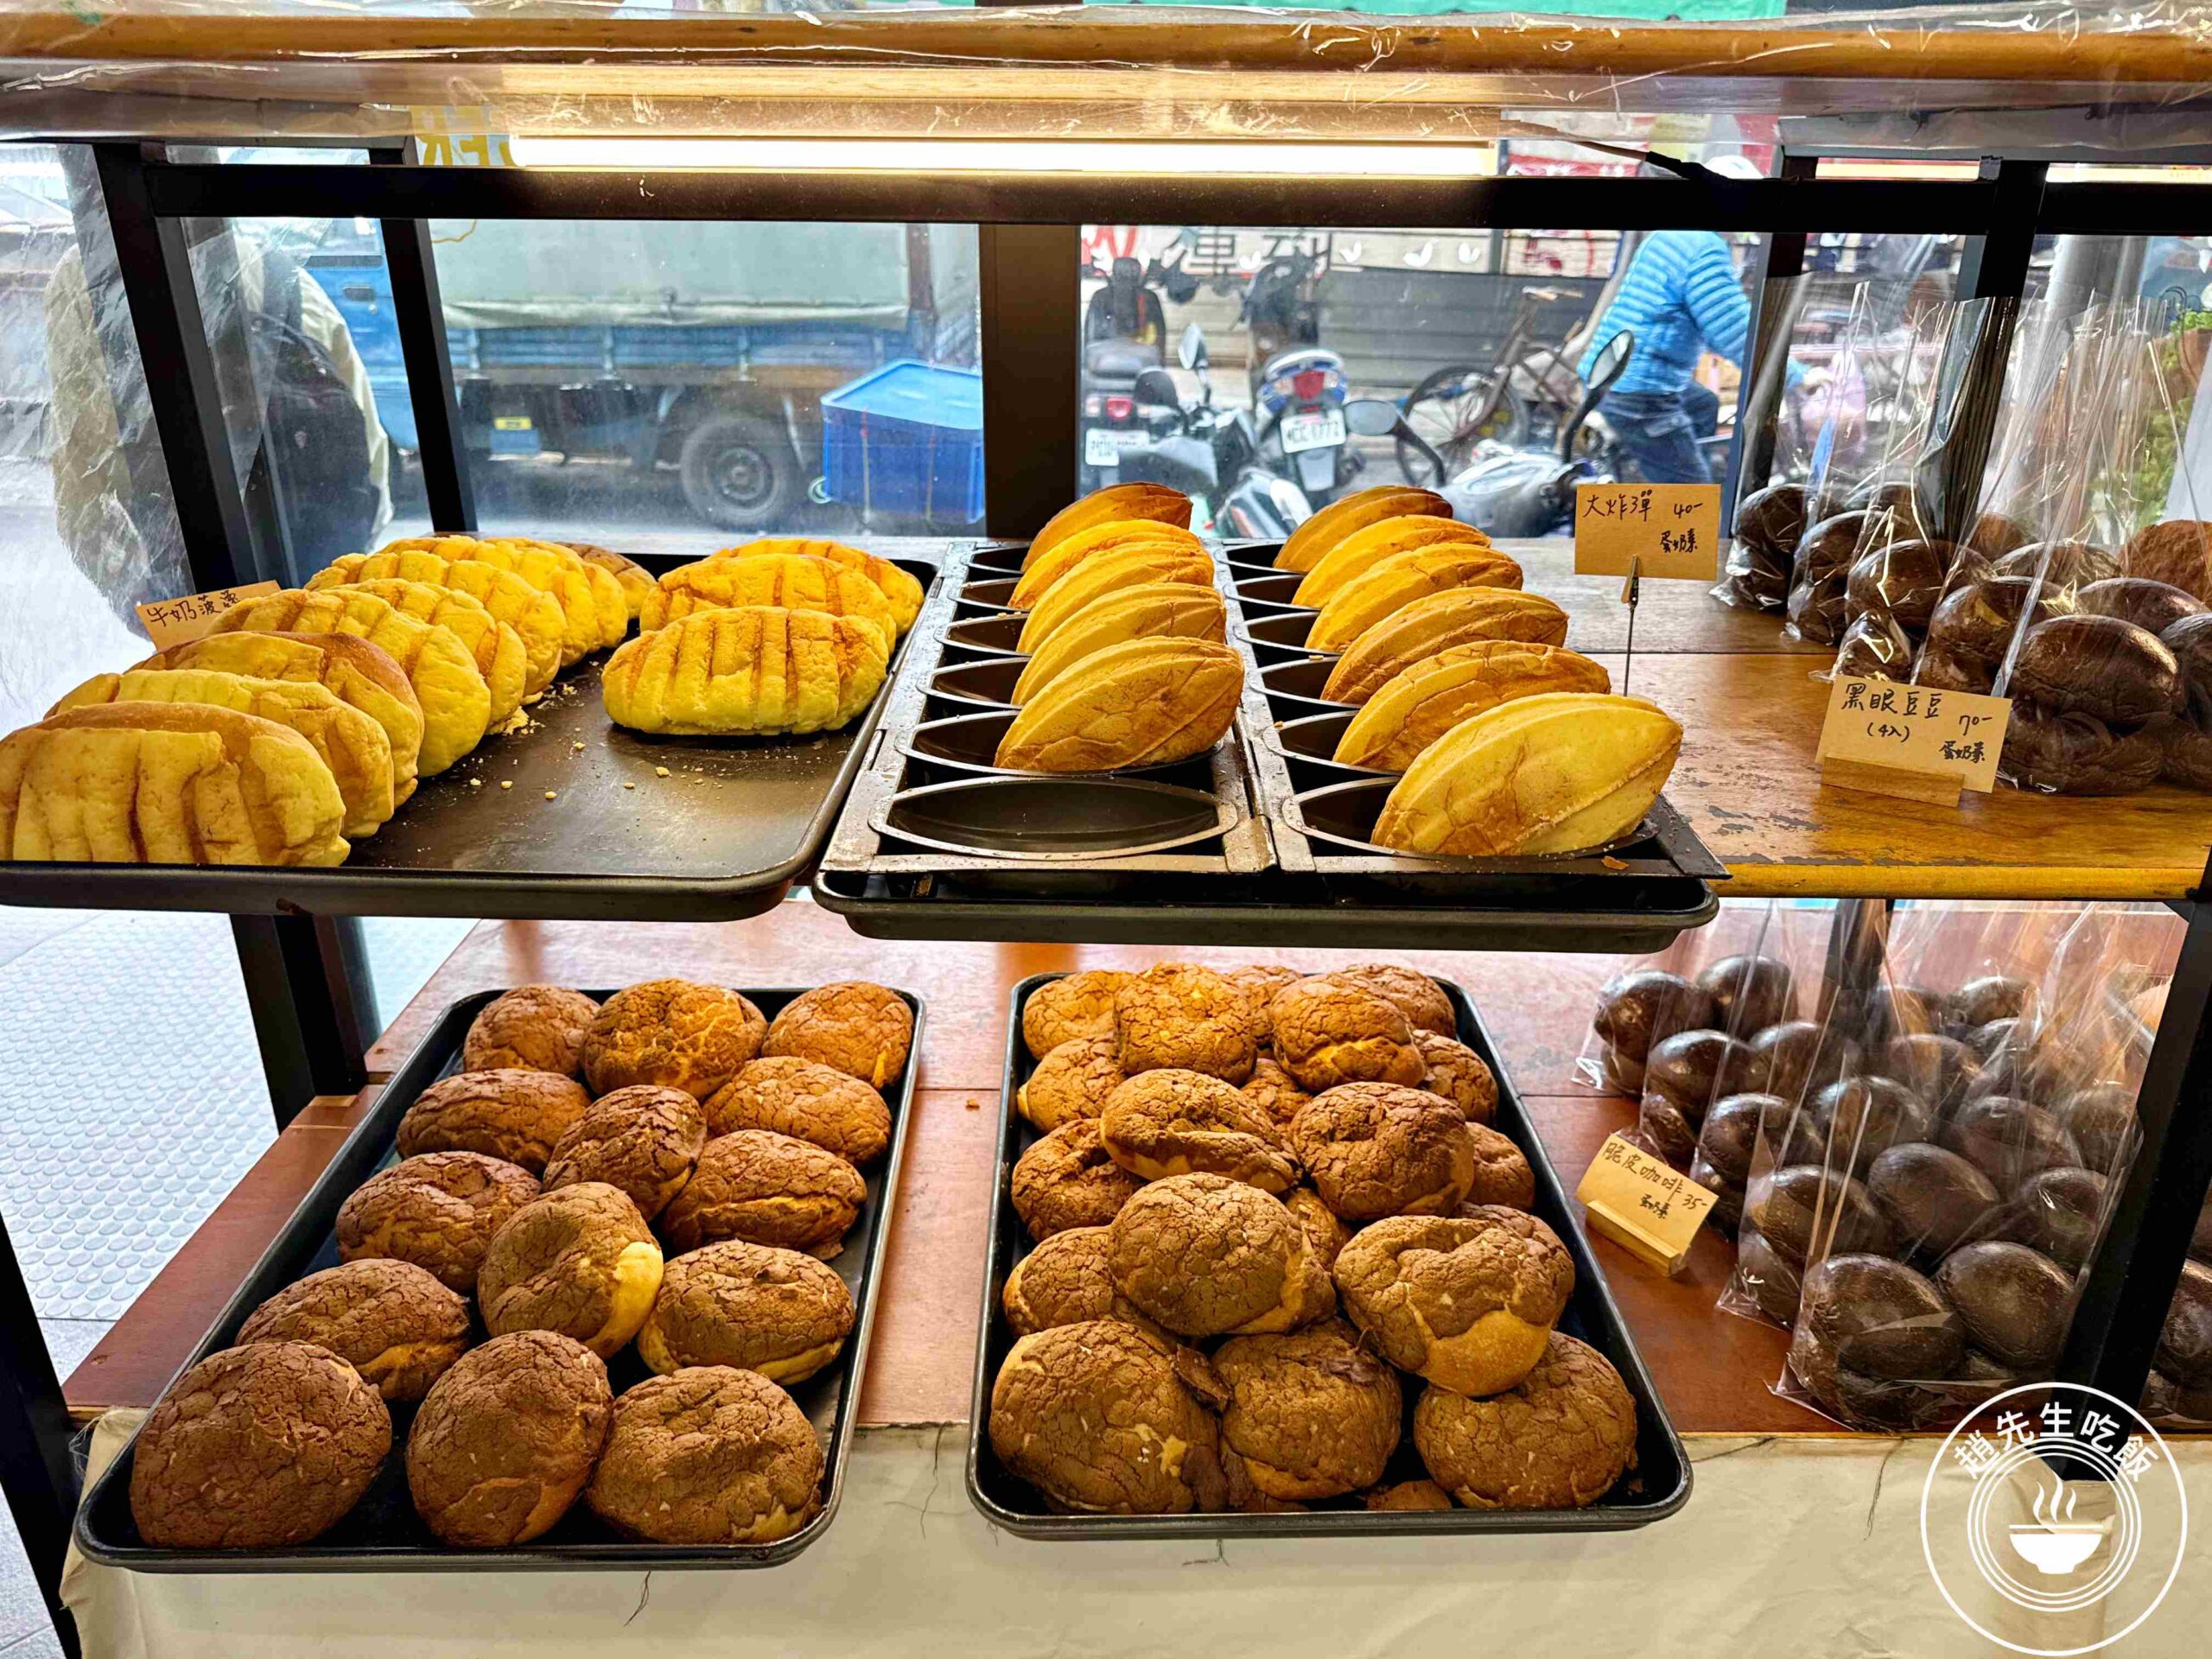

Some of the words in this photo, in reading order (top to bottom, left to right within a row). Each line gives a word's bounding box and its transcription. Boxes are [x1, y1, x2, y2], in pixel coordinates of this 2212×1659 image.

[1583, 489, 1653, 522] 大炸彈
[1841, 683, 1943, 719] 黑眼豆豆
[1602, 1142, 1684, 1202] 脆皮咖啡
